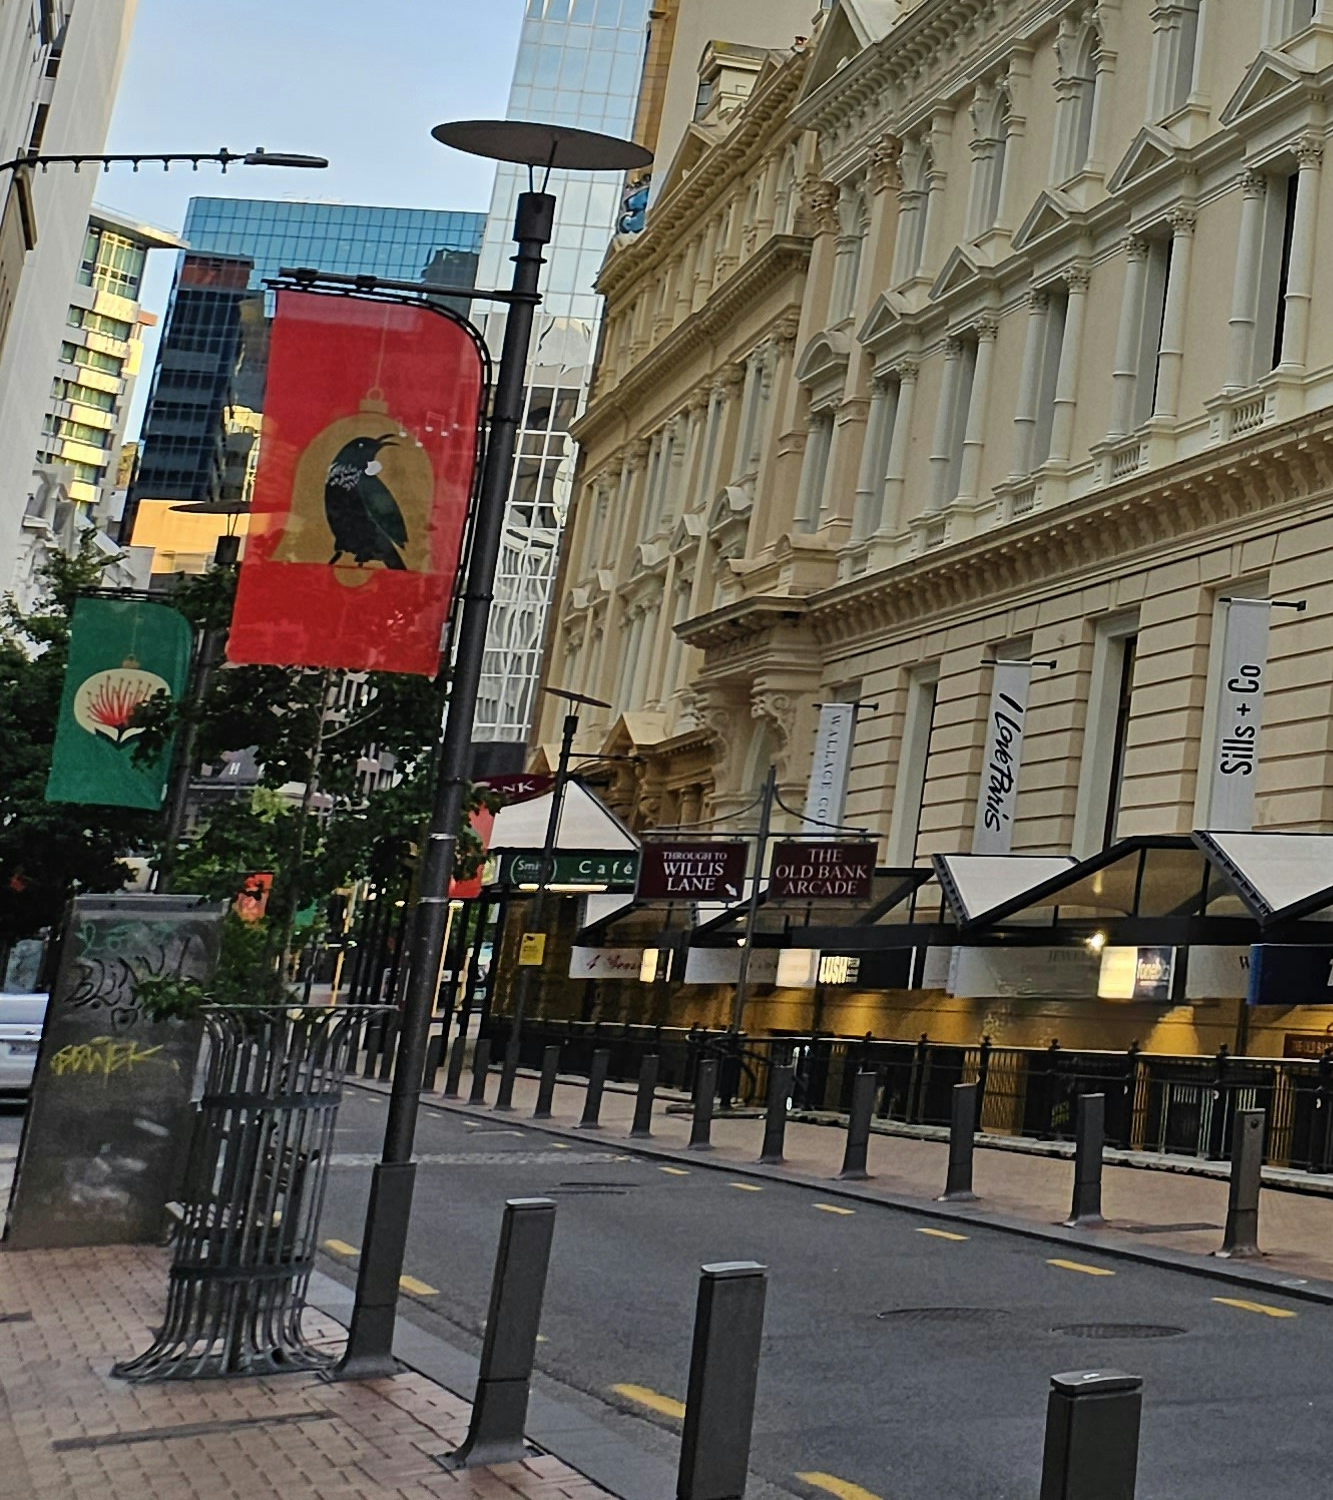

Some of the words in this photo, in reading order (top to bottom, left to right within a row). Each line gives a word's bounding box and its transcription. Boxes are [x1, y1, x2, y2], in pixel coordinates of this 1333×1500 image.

[1227, 664, 1261, 694] Co
[819, 714, 843, 790] WALLACE
[1219, 725, 1256, 776] Sills
[662, 851, 713, 861] THROUGH
[714, 851, 728, 861] TO
[808, 848, 843, 863] THE
[578, 859, 634, 875] Café
[662, 861, 725, 877] WILLIS
[775, 864, 815, 879] OLD
[818, 864, 868, 880] BANK
[666, 877, 716, 892] LANE
[782, 880, 858, 895] ARCADE
[818, 956, 850, 985] LUSH
